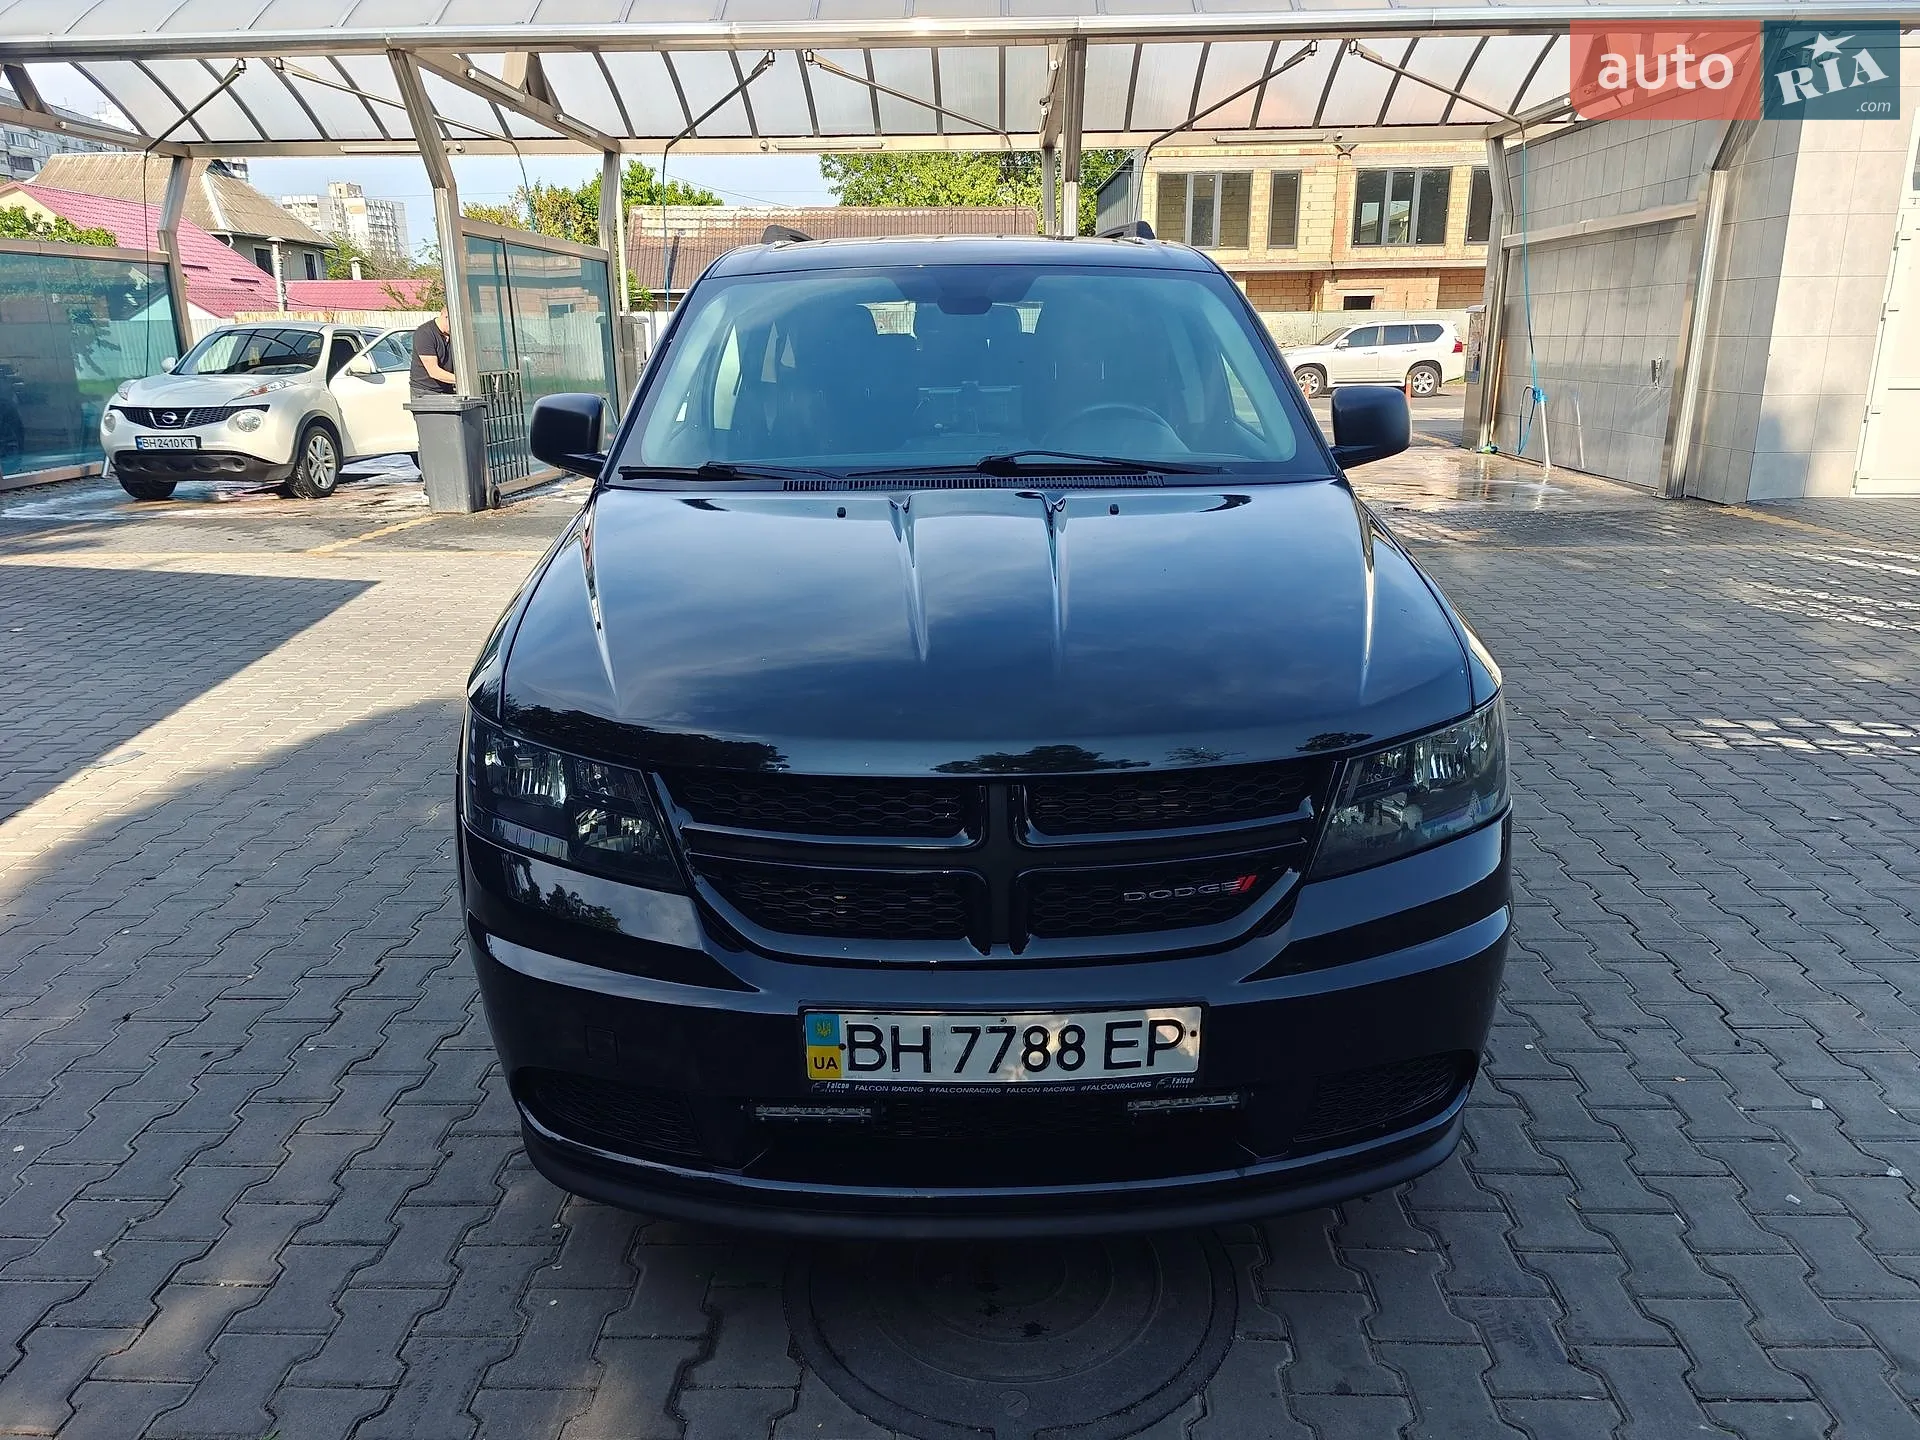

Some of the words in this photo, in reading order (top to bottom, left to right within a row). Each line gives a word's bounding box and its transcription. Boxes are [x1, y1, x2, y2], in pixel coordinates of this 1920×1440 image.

[1123, 880, 1241, 901] DODGE
[847, 1024, 932, 1073] BH
[951, 1024, 1086, 1073] 7788
[1104, 1019, 1187, 1070] EP
[813, 1056, 839, 1070] UA
[826, 1081, 850, 1089] Falcon
[854, 1084, 889, 1092] FALCON
[1043, 1085, 1076, 1093] RACING
[1081, 1081, 1152, 1092] #FALCONRACING
[1171, 1076, 1195, 1085] Falcon
